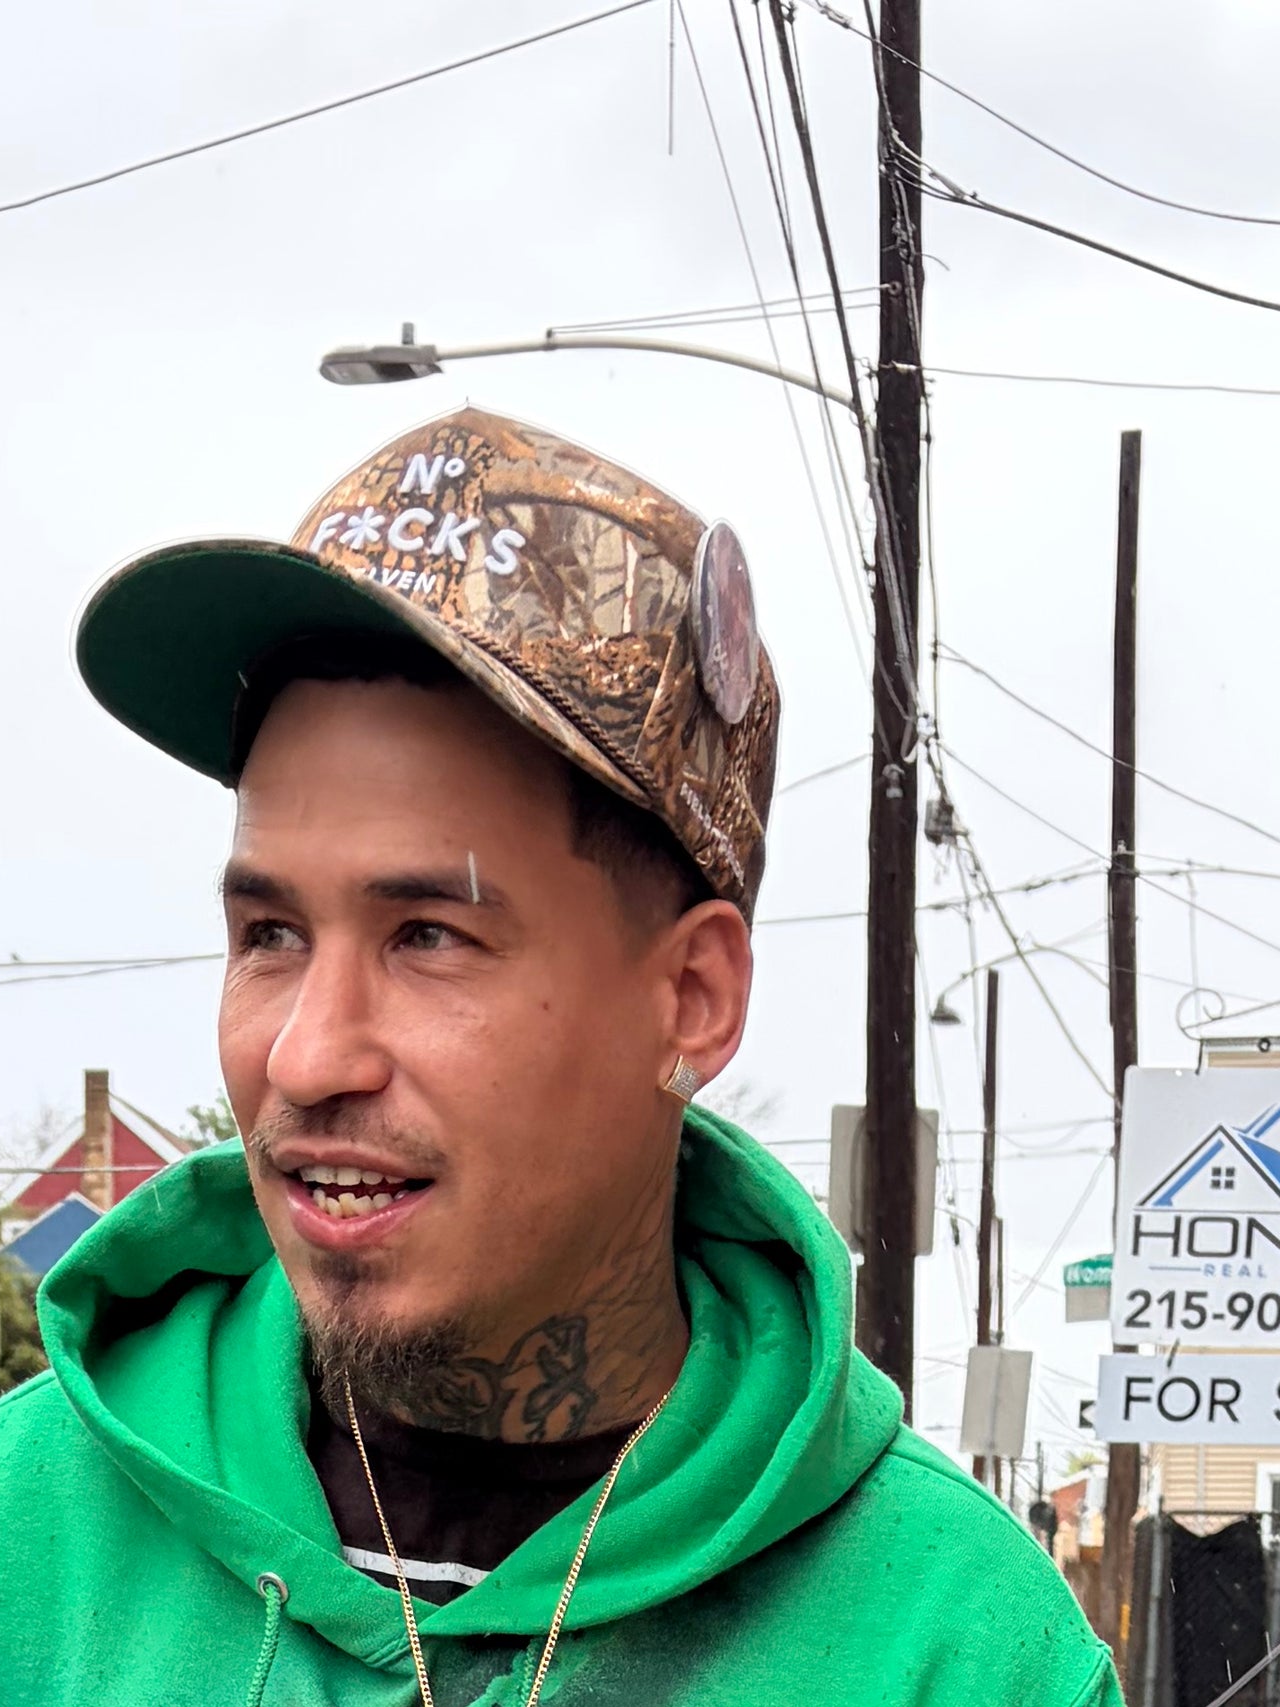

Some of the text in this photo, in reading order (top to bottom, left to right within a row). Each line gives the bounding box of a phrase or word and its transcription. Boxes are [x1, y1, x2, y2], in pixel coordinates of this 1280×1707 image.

[352, 567, 438, 594] IVEN
[1203, 1263, 1268, 1279] REAL
[1122, 1376, 1242, 1424] FOR
